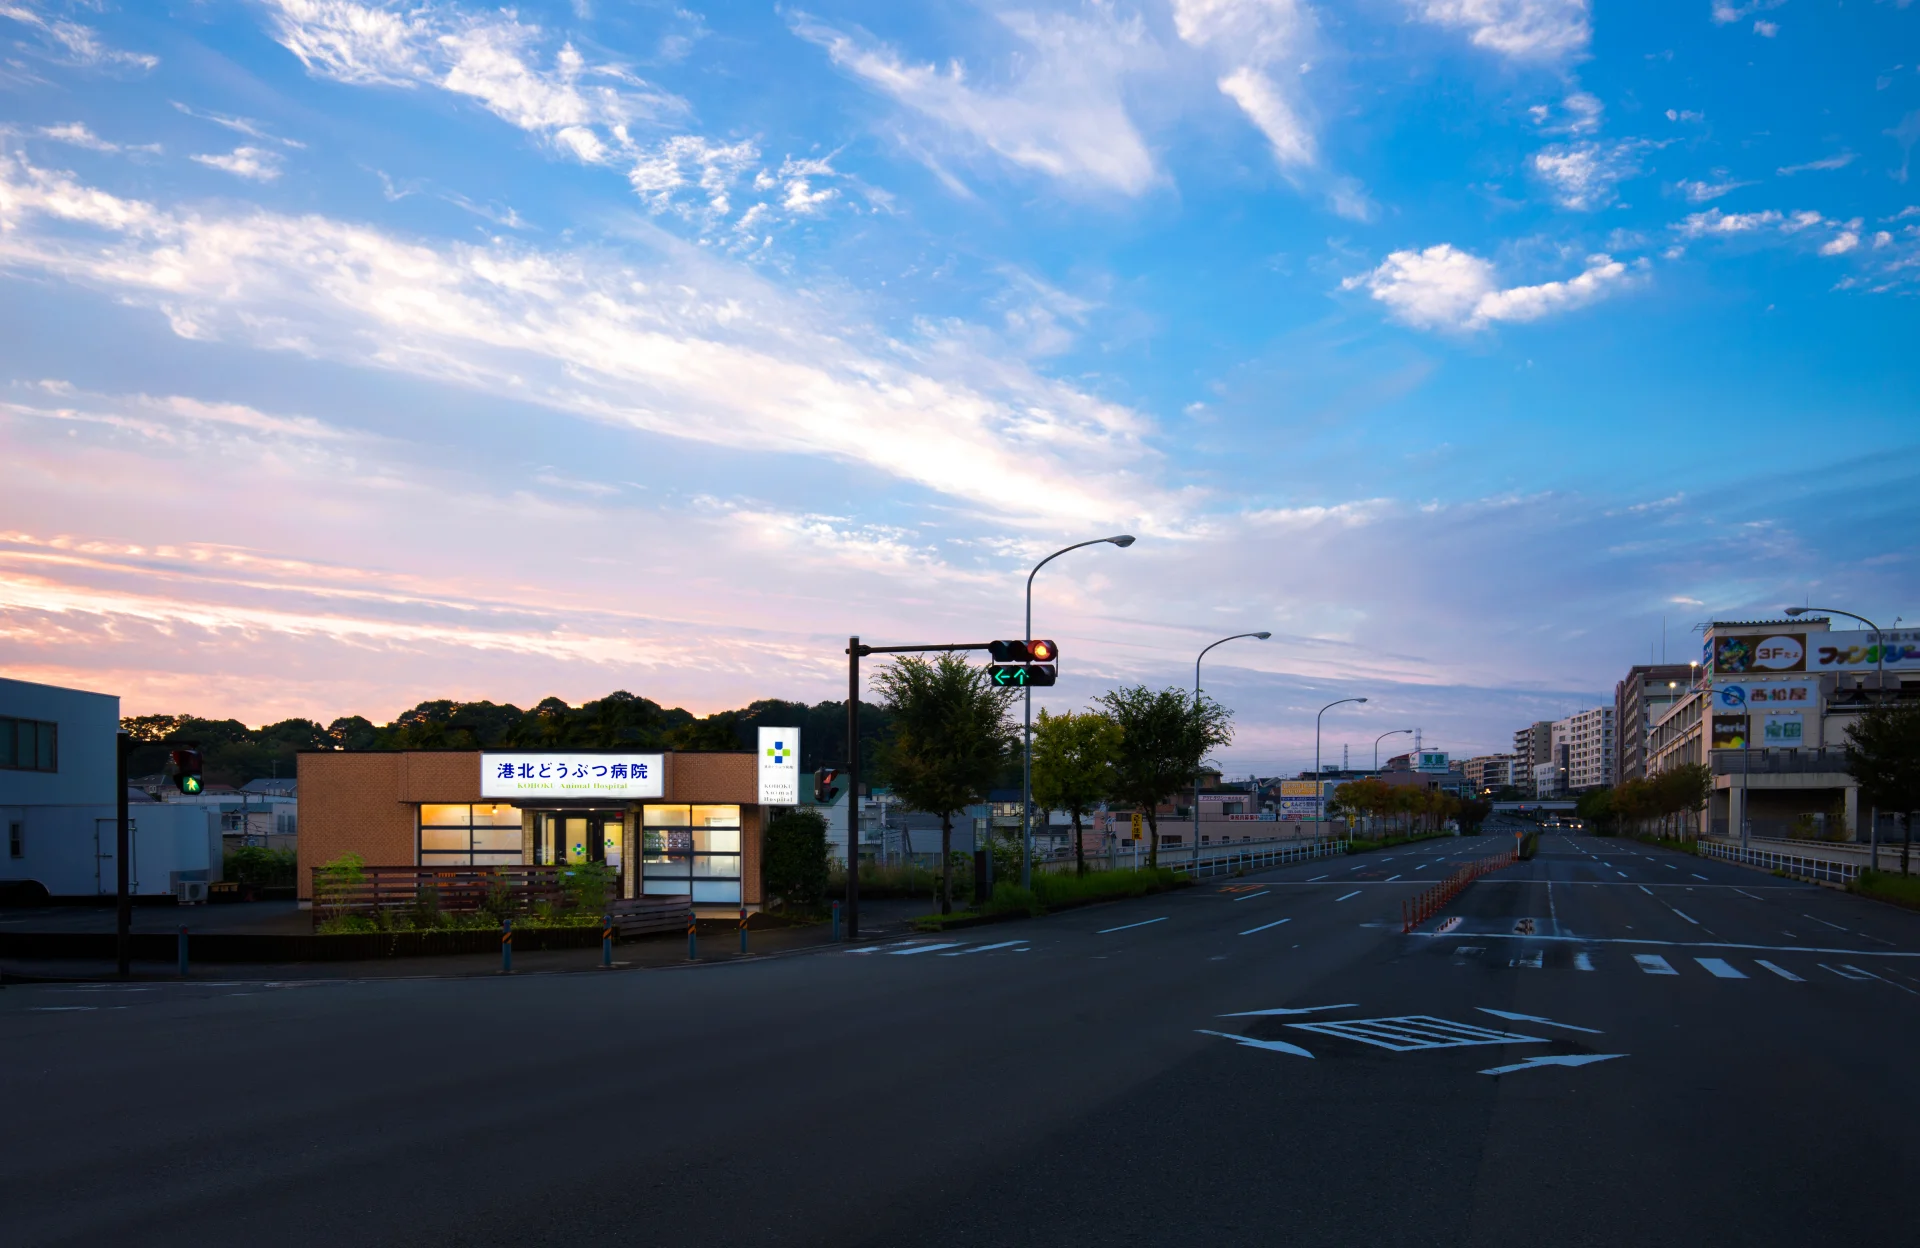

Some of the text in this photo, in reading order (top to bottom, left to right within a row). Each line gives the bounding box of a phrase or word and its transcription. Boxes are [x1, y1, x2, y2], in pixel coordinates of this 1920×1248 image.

[1750, 687, 1807, 702] 西松屋
[1714, 722, 1747, 733] Seria
[497, 762, 648, 779] 港北どうぶつ病院
[594, 782, 628, 791] Hospital
